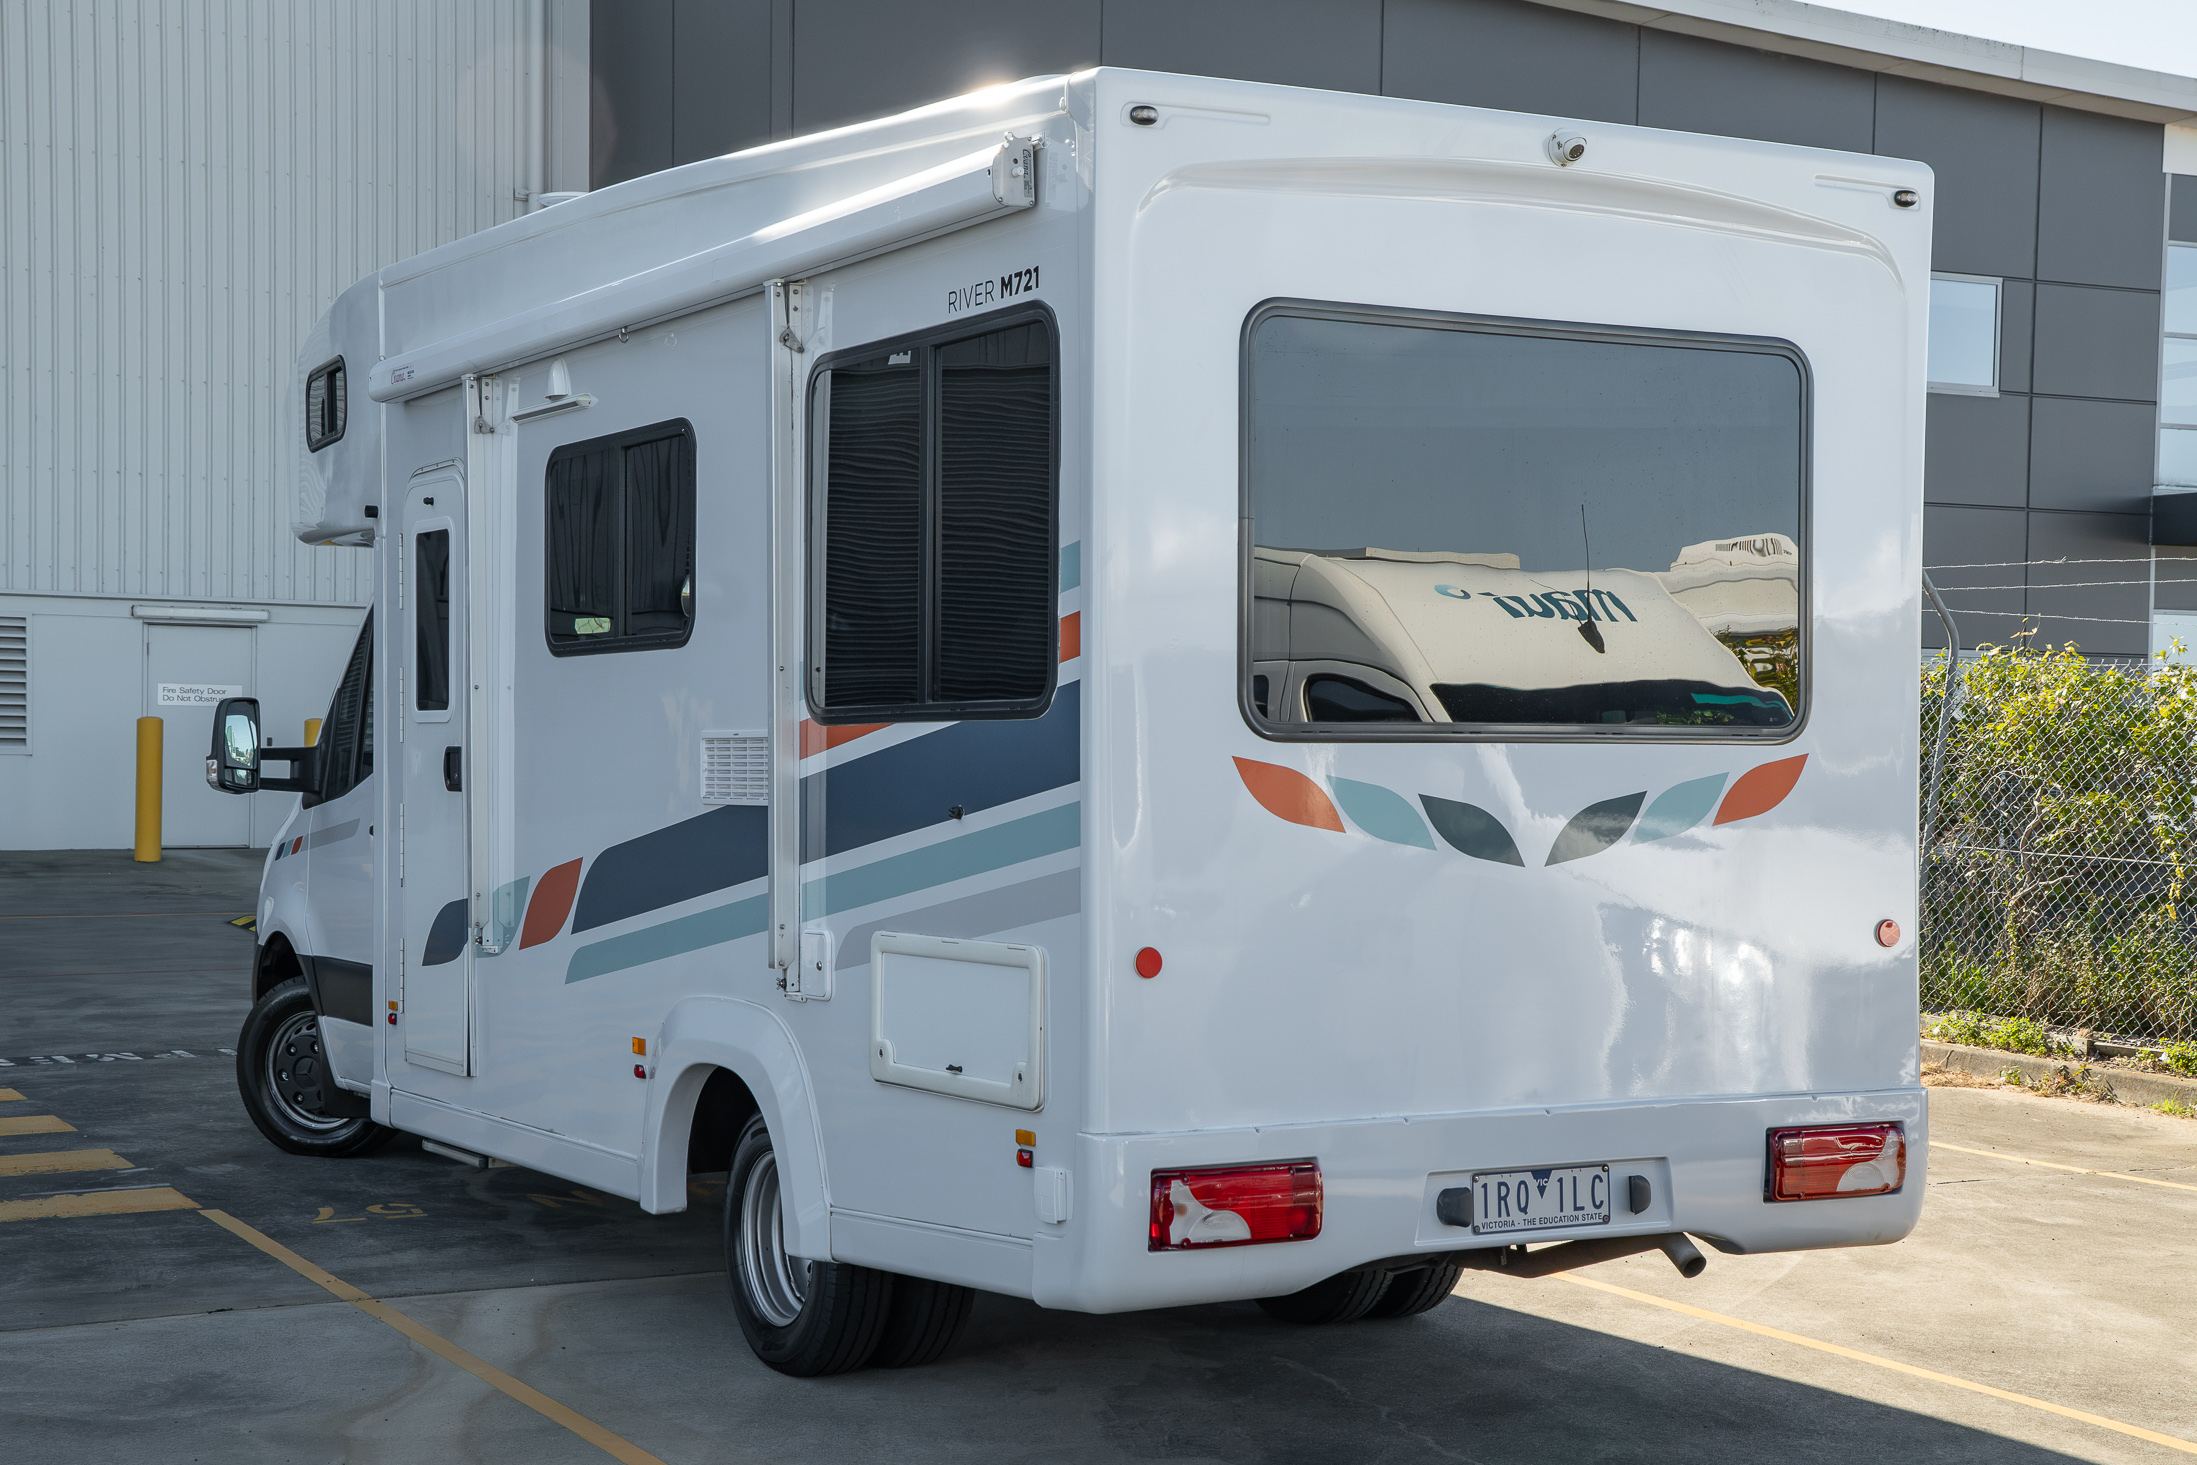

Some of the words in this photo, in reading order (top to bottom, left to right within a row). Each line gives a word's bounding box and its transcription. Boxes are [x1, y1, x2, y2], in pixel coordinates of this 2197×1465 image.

[948, 280, 995, 314] RIVER
[1000, 265, 1040, 299] M721
[162, 686, 177, 694] Fire
[179, 687, 205, 695] Safety
[207, 687, 227, 695] Door
[162, 694, 175, 702] Do
[176, 694, 191, 702] Not
[193, 695, 227, 703] Obstru
[1481, 1179, 1530, 1219] 1RQ
[1556, 1173, 1604, 1213] 1LC
[1481, 1219, 1516, 1230] VICTORIA
[1522, 1217, 1537, 1226] THE
[1539, 1214, 1580, 1225] EDUCATION
[1581, 1212, 1603, 1221] STATE
